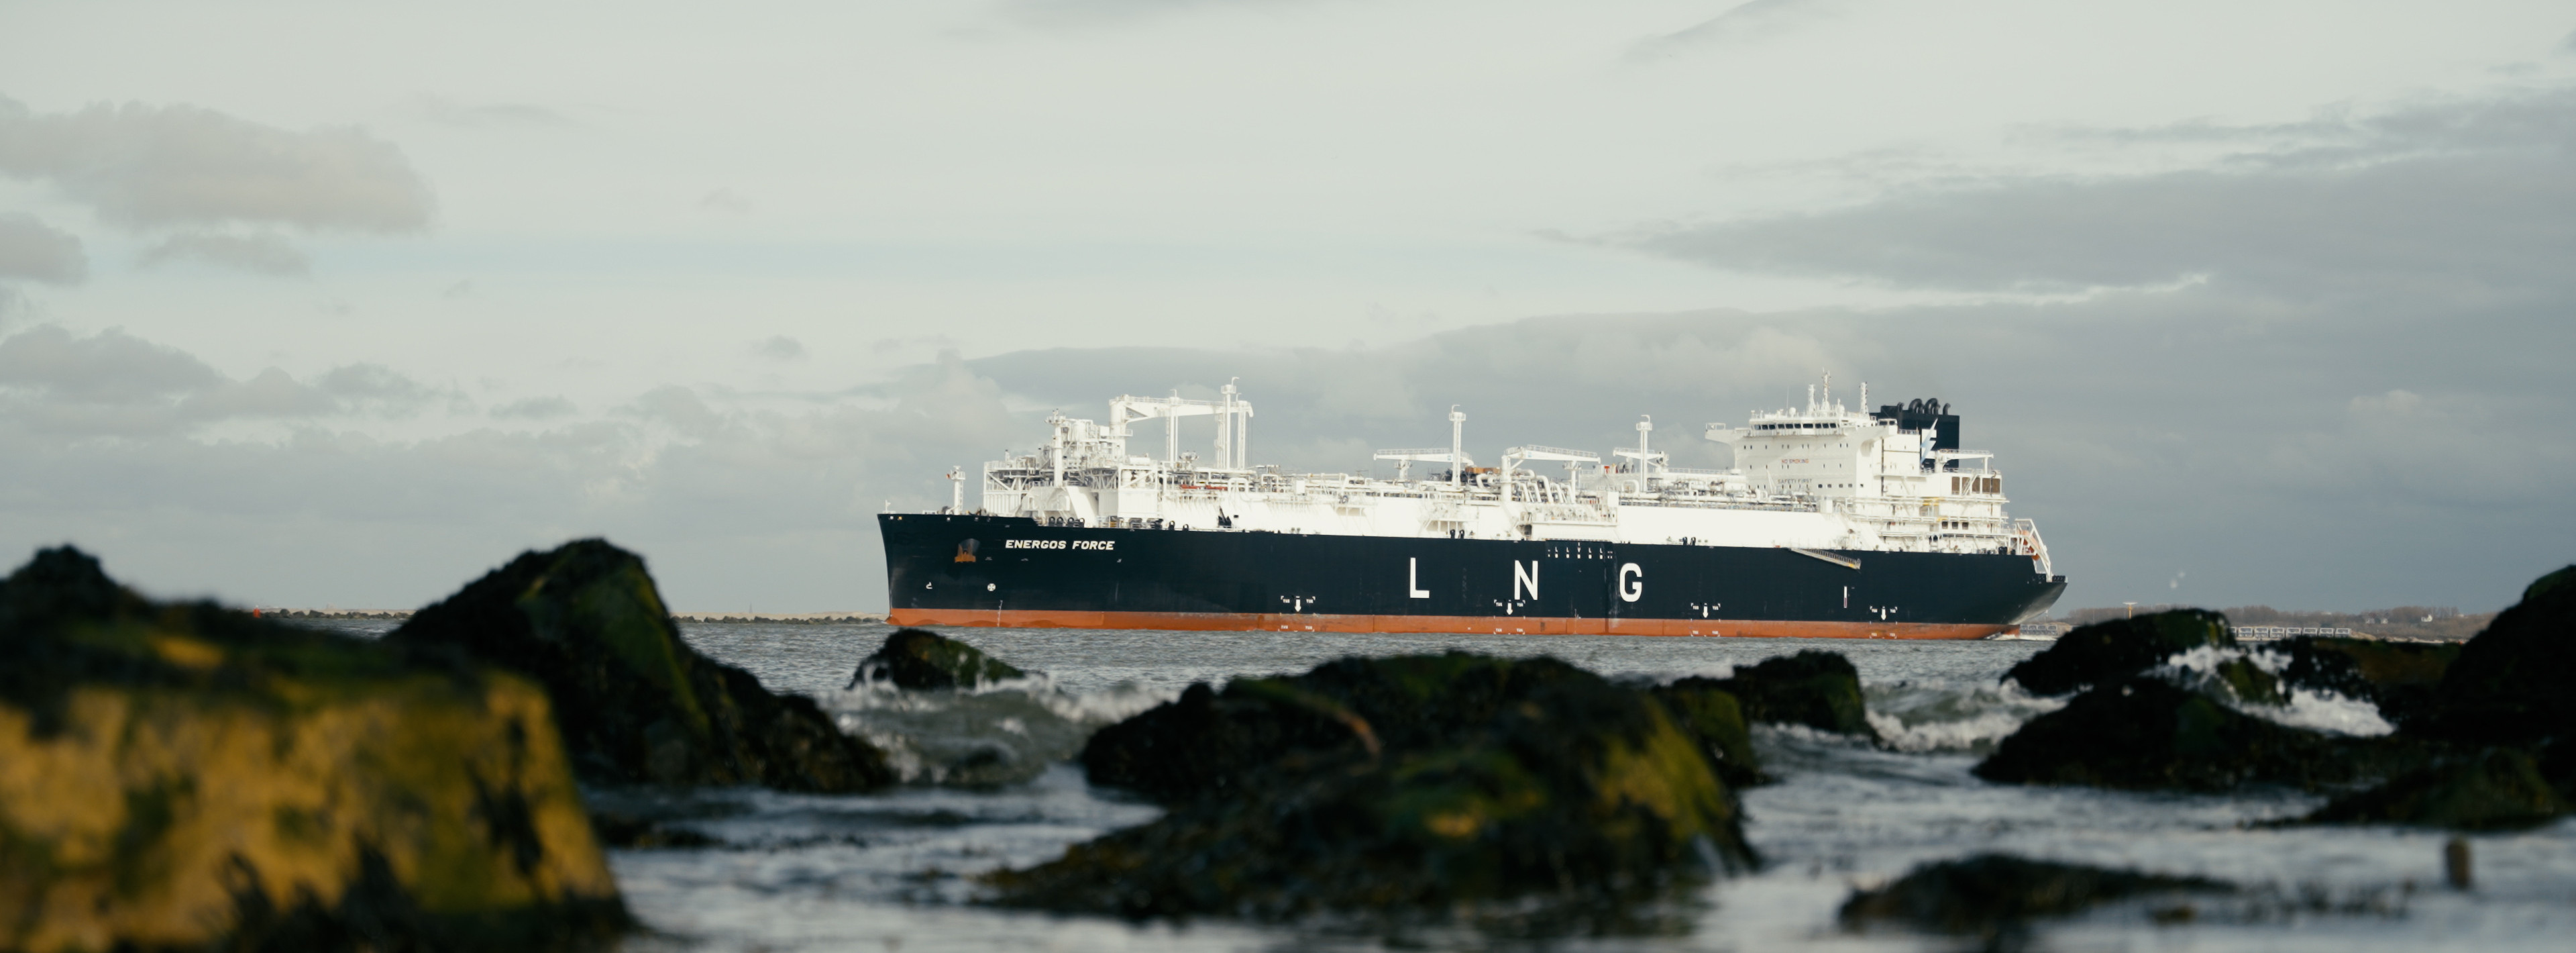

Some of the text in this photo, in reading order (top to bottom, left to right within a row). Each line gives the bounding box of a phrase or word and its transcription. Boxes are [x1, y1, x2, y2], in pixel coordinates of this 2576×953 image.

[1005, 540, 1116, 550] ENERGOS FORCE
[1409, 557, 1642, 603] L N G
